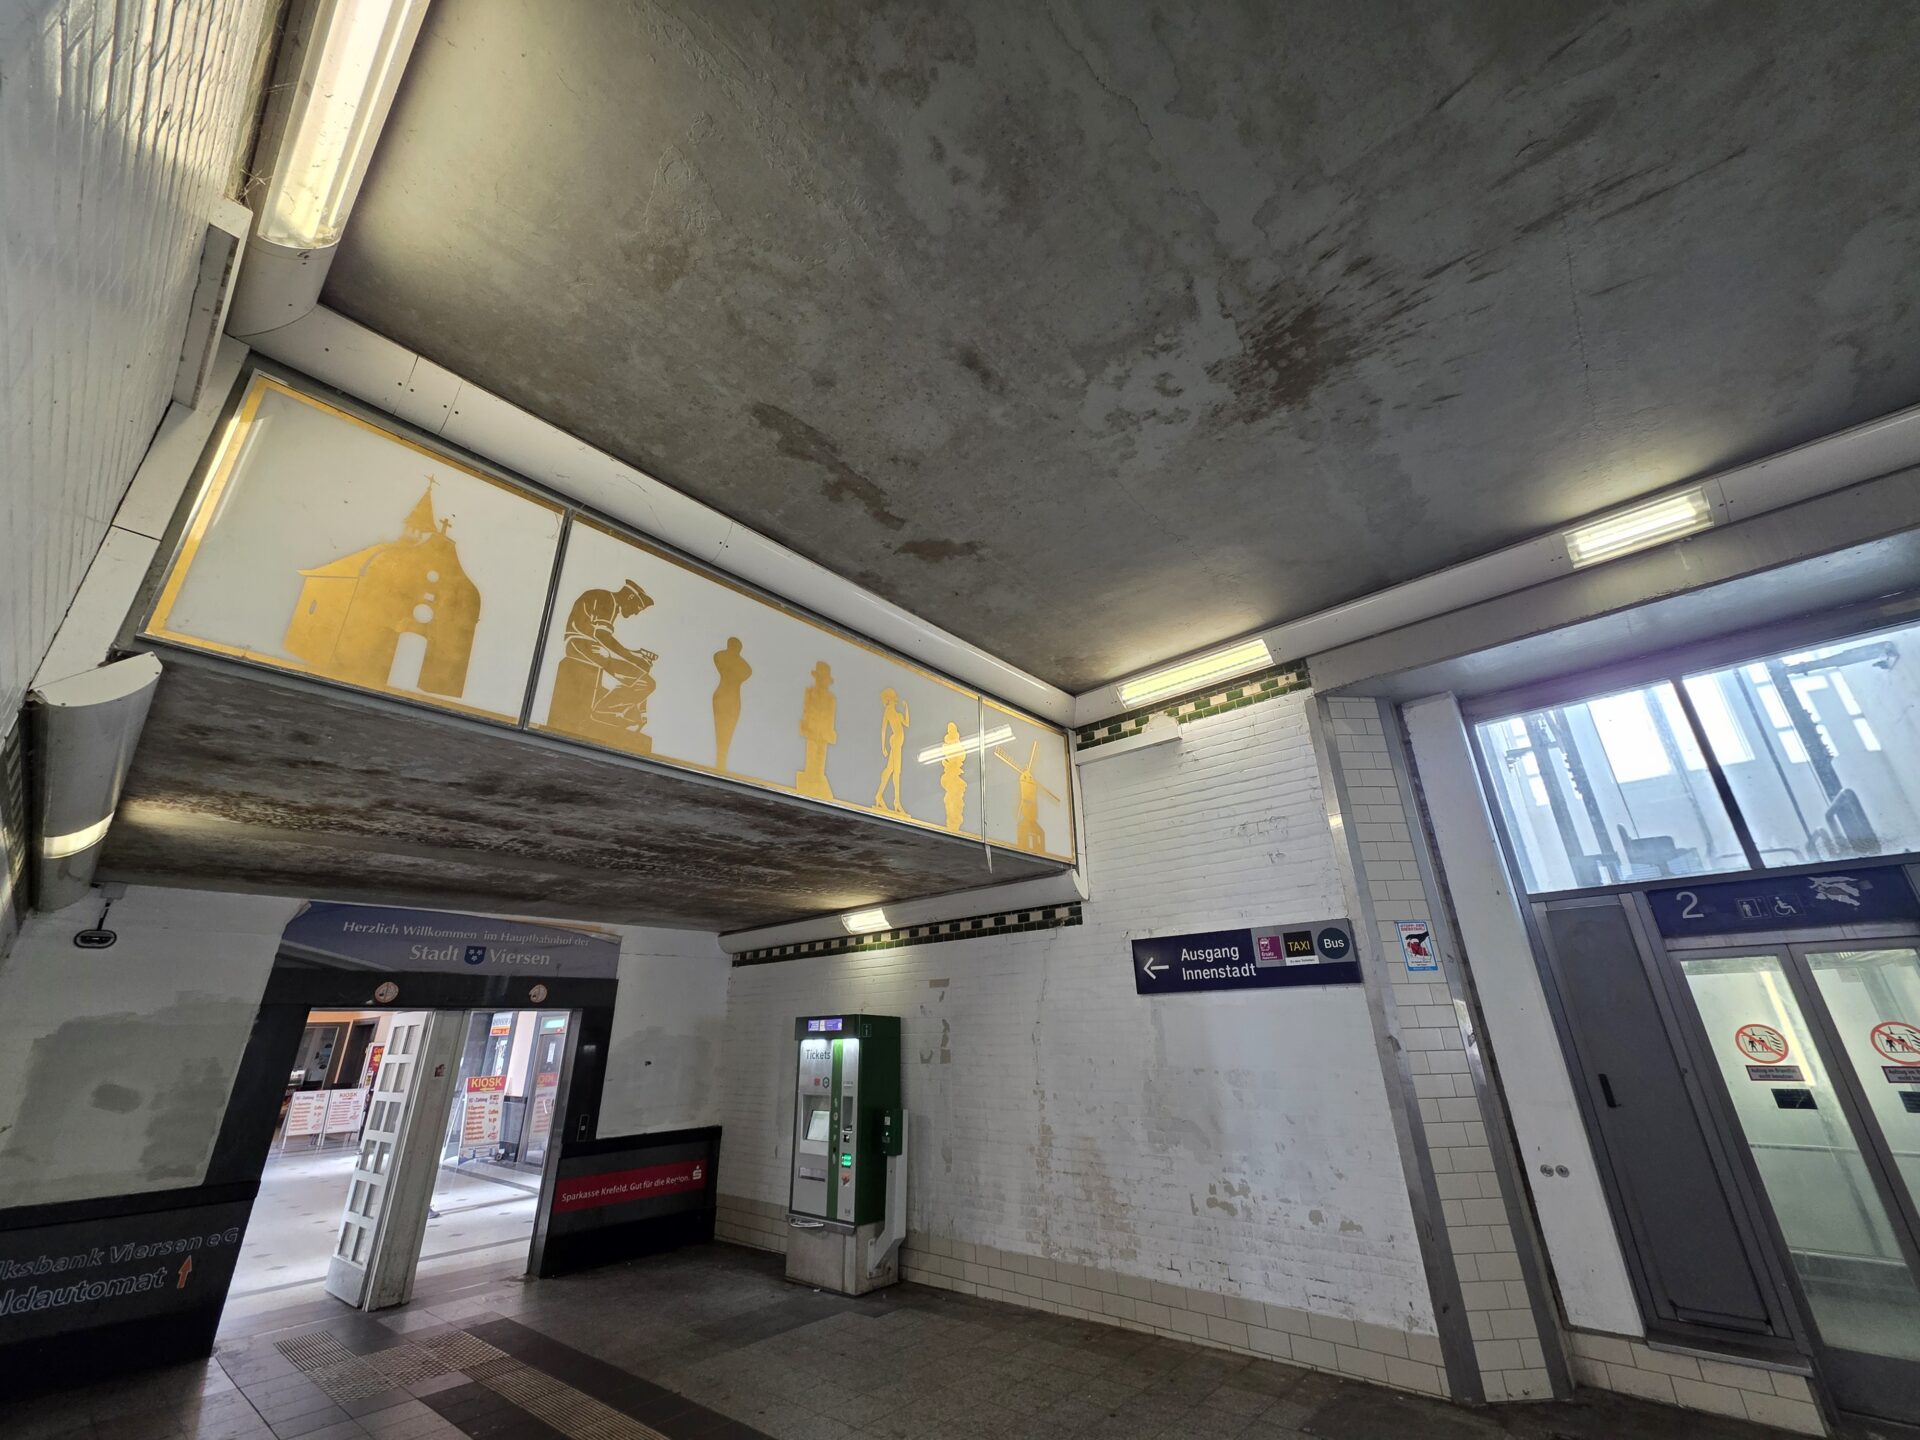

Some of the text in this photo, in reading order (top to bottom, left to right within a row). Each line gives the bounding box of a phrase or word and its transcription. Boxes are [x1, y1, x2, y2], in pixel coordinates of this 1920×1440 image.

[1676, 891, 1705, 919] 2
[343, 921, 399, 934] Herzlich
[403, 925, 477, 939] Willkommen
[484, 930, 498, 940] im
[1287, 940, 1311, 952] TAXI
[1323, 938, 1345, 949] Bus
[409, 944, 551, 965] Stadt Viersen
[1181, 946, 1240, 963] Ausgang
[1182, 963, 1257, 980] Innenstadt
[806, 1049, 831, 1060] Tickets
[471, 1077, 502, 1088] KIOSK
[562, 1191, 600, 1204] Sparkasse
[600, 1184, 629, 1196] Krefeld.
[629, 1181, 643, 1191] Gut
[643, 1179, 654, 1189] für
[654, 1177, 665, 1187] die
[110, 1236, 203, 1263] Viersen
[206, 1227, 240, 1248] eG
[0, 1267, 168, 1317] ldautomat
